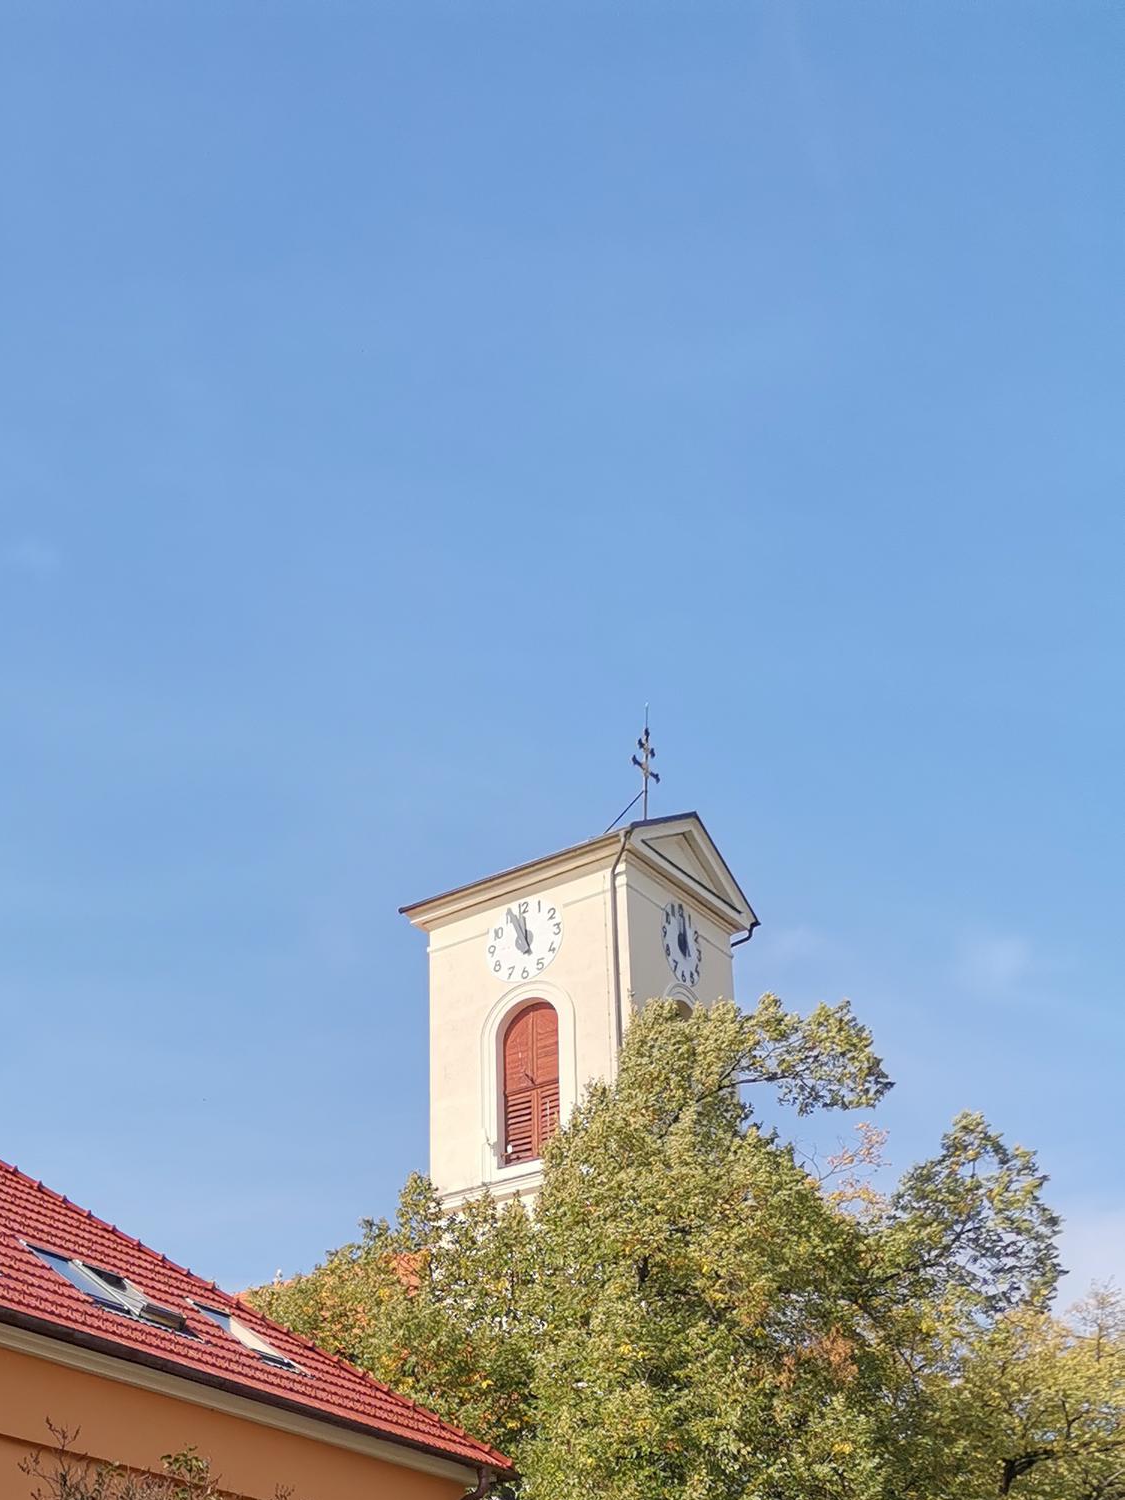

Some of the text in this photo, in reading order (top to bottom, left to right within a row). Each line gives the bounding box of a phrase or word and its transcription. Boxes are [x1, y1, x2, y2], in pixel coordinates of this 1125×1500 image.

[547, 907, 556, 921] 2
[493, 927, 504, 941] 10
[552, 921, 562, 935] 3
[488, 945, 497, 958] 9
[547, 941, 556, 954] 4
[493, 959, 502, 973] 8
[536, 957, 546, 971] 5
[507, 964, 516, 980] 7
[521, 966, 530, 980] 6
